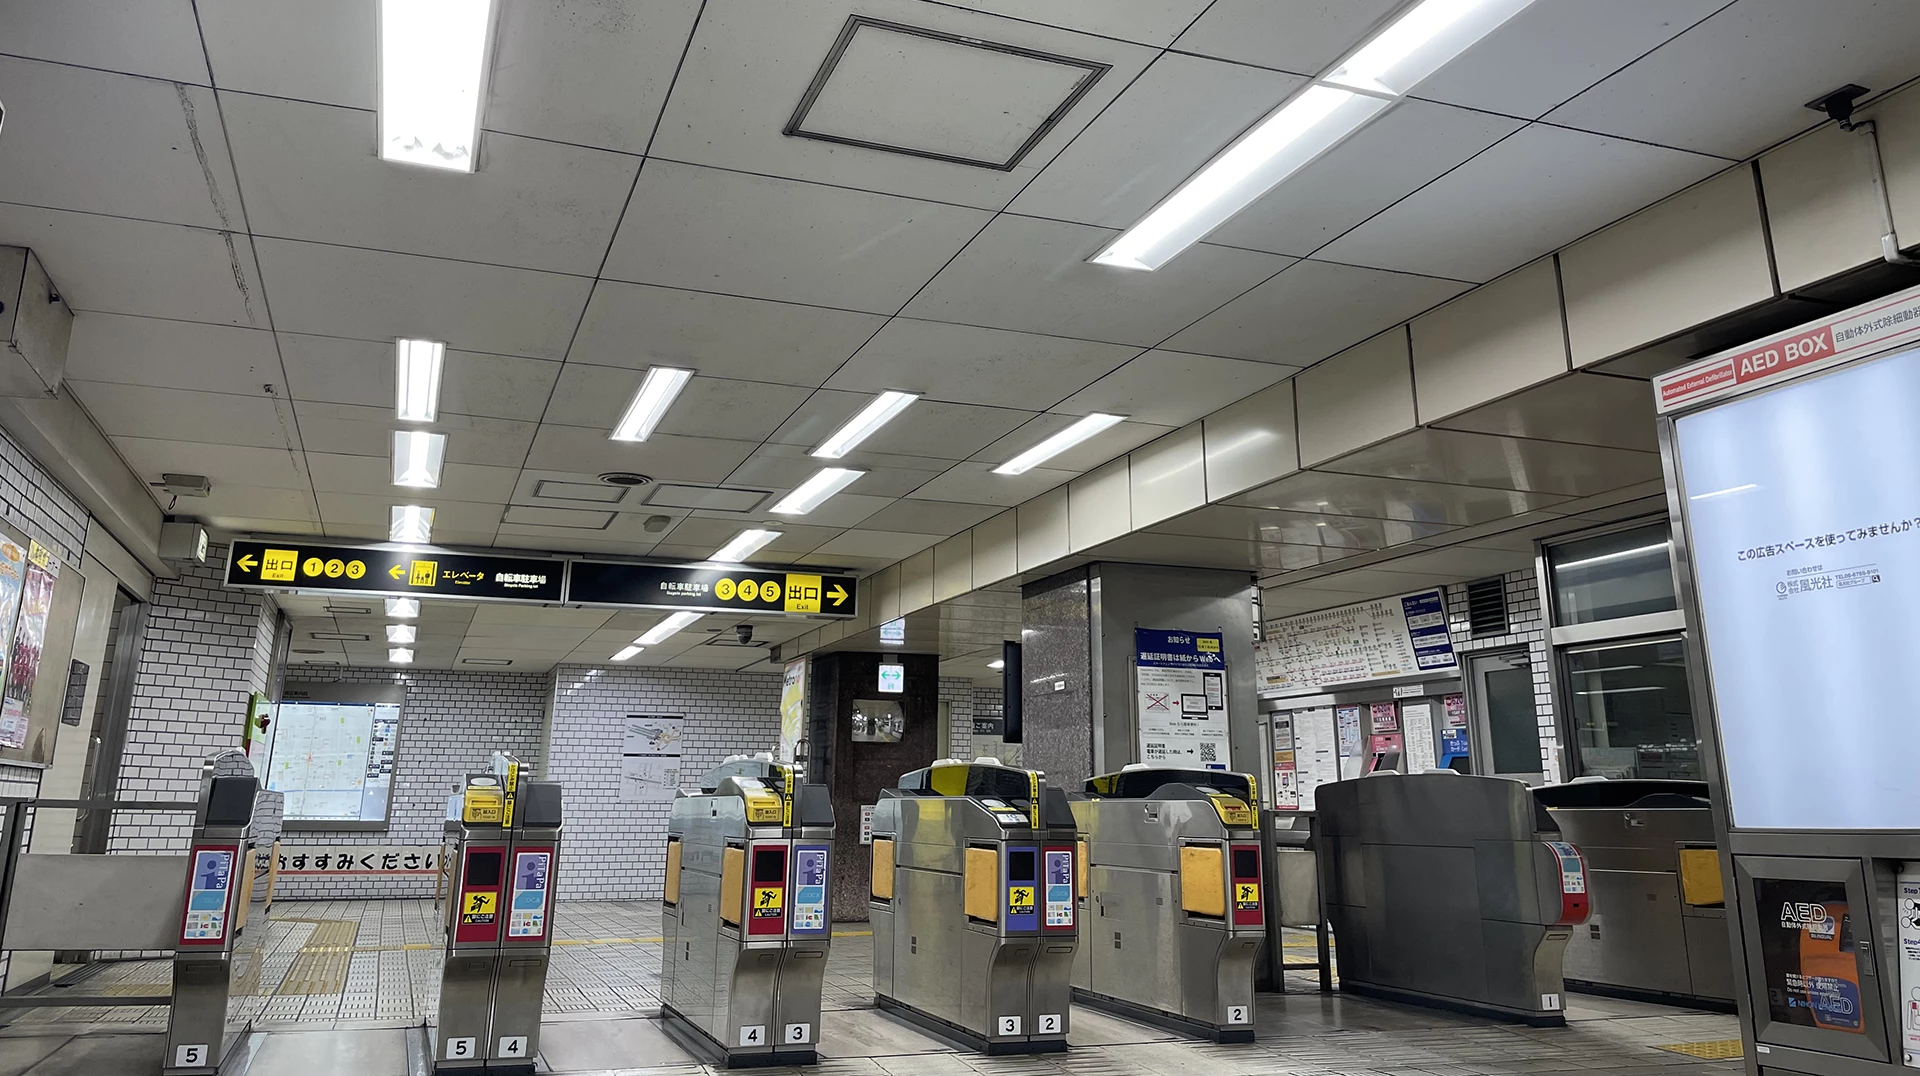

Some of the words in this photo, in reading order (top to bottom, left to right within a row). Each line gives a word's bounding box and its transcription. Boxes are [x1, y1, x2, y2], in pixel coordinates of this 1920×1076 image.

[1740, 351, 1780, 377] AED
[1784, 332, 1828, 362] BOX
[1662, 382, 1686, 397] Automated
[1686, 377, 1706, 391] External
[1706, 368, 1734, 385] Defibrillator
[265, 558, 293, 571] 出口
[310, 562, 316, 572] 1
[330, 564, 338, 574] 2
[352, 565, 360, 575] 3
[442, 570, 484, 580] エレベータ
[495, 572, 547, 584] 自転車駐車場
[1800, 575, 1834, 592] 風光社
[721, 584, 730, 595] 3
[744, 585, 752, 596] 4
[766, 586, 774, 597] 5
[788, 584, 818, 600] 出口
[1167, 636, 1191, 644] お知らせ
[216, 854, 230, 889] PiTaPa
[535, 855, 548, 889] PiTaPa
[815, 854, 824, 885] PiTaPa
[1062, 854, 1070, 884] PiTaPa
[1781, 902, 1827, 923] AED
[1820, 996, 1853, 1014] AED
[1233, 1008, 1242, 1021] 2
[1005, 1019, 1015, 1032] 3
[1045, 1017, 1055, 1031] 2
[748, 1029, 758, 1042] 4
[793, 1027, 803, 1040] 3
[186, 1048, 198, 1063] 5
[456, 1041, 467, 1056] 5
[508, 1040, 518, 1054] 4
